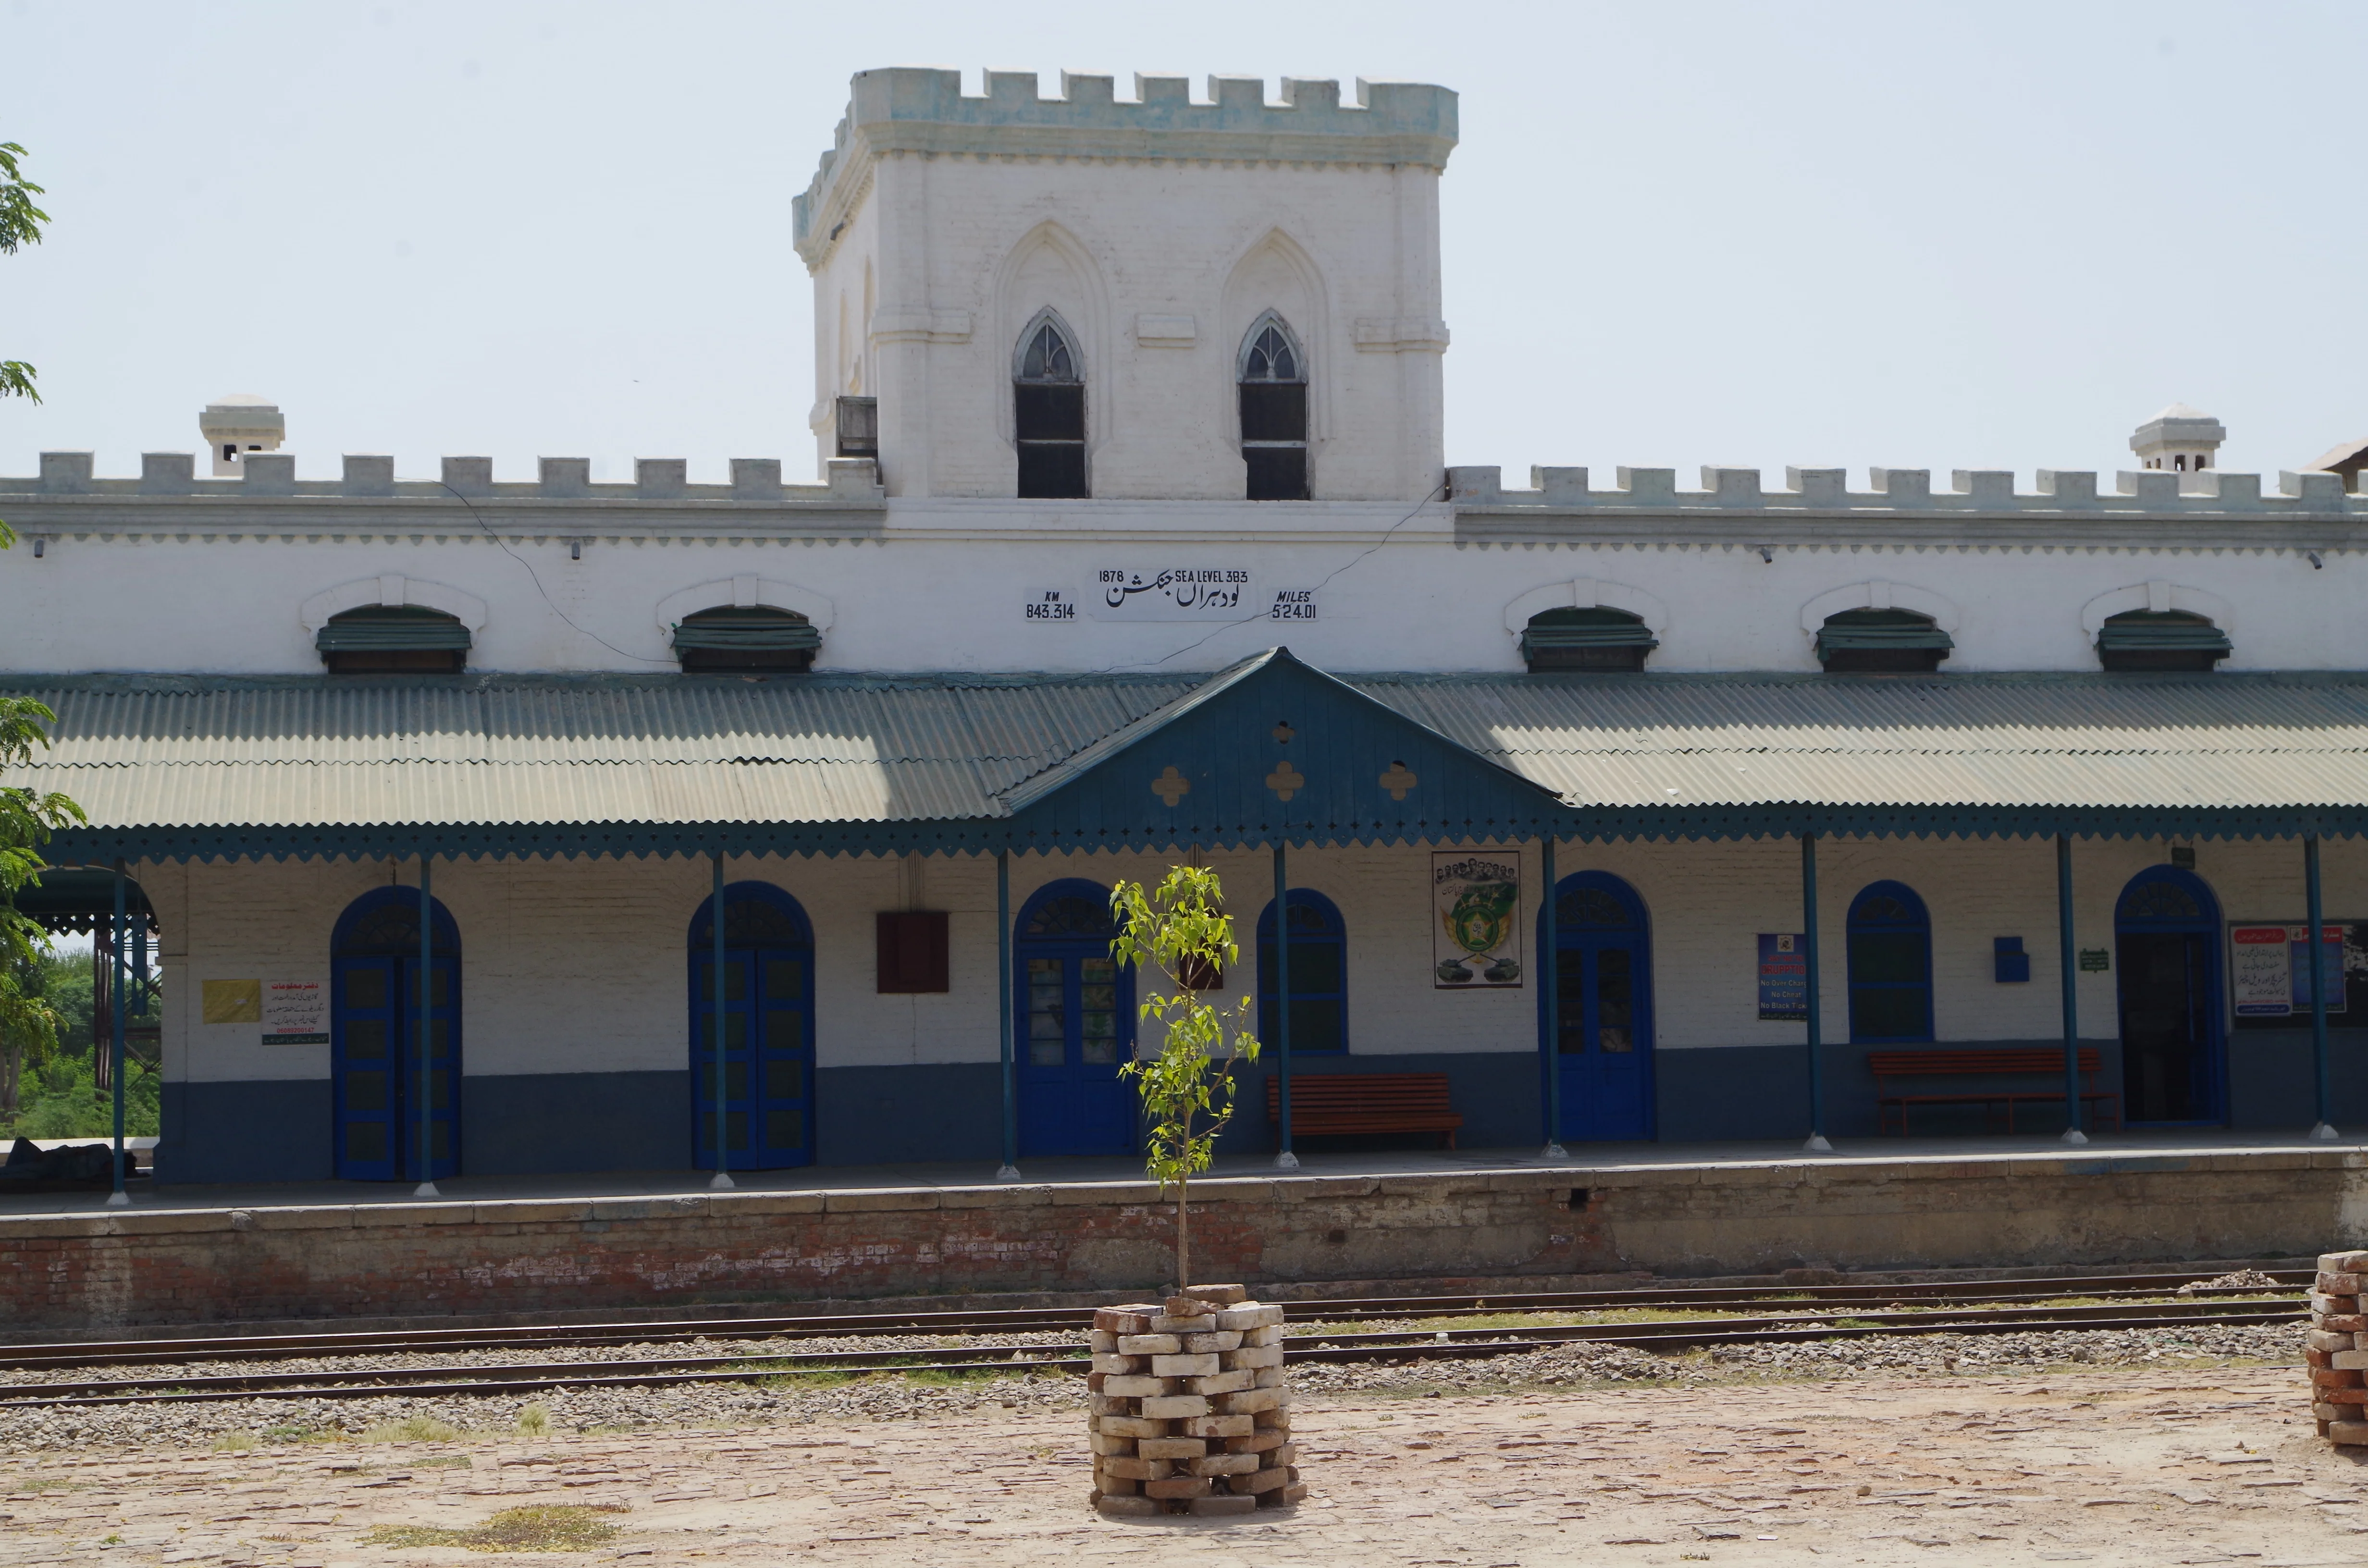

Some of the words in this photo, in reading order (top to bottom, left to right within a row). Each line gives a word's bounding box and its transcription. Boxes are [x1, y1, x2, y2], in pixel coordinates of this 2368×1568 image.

[1099, 570, 1124, 583] 1878
[1175, 570, 1194, 582] SEA
[1197, 570, 1224, 583] LEVEL
[1226, 571, 1248, 583] 383
[1106, 569, 1174, 608] جنکشن
[1045, 591, 1060, 602] KM
[1276, 591, 1311, 603] MILES
[1026, 604, 1075, 619] 843.314
[1272, 604, 1316, 619] 524.01
[1442, 883, 1458, 897] پاکستان
[271, 982, 302, 991] معلومات
